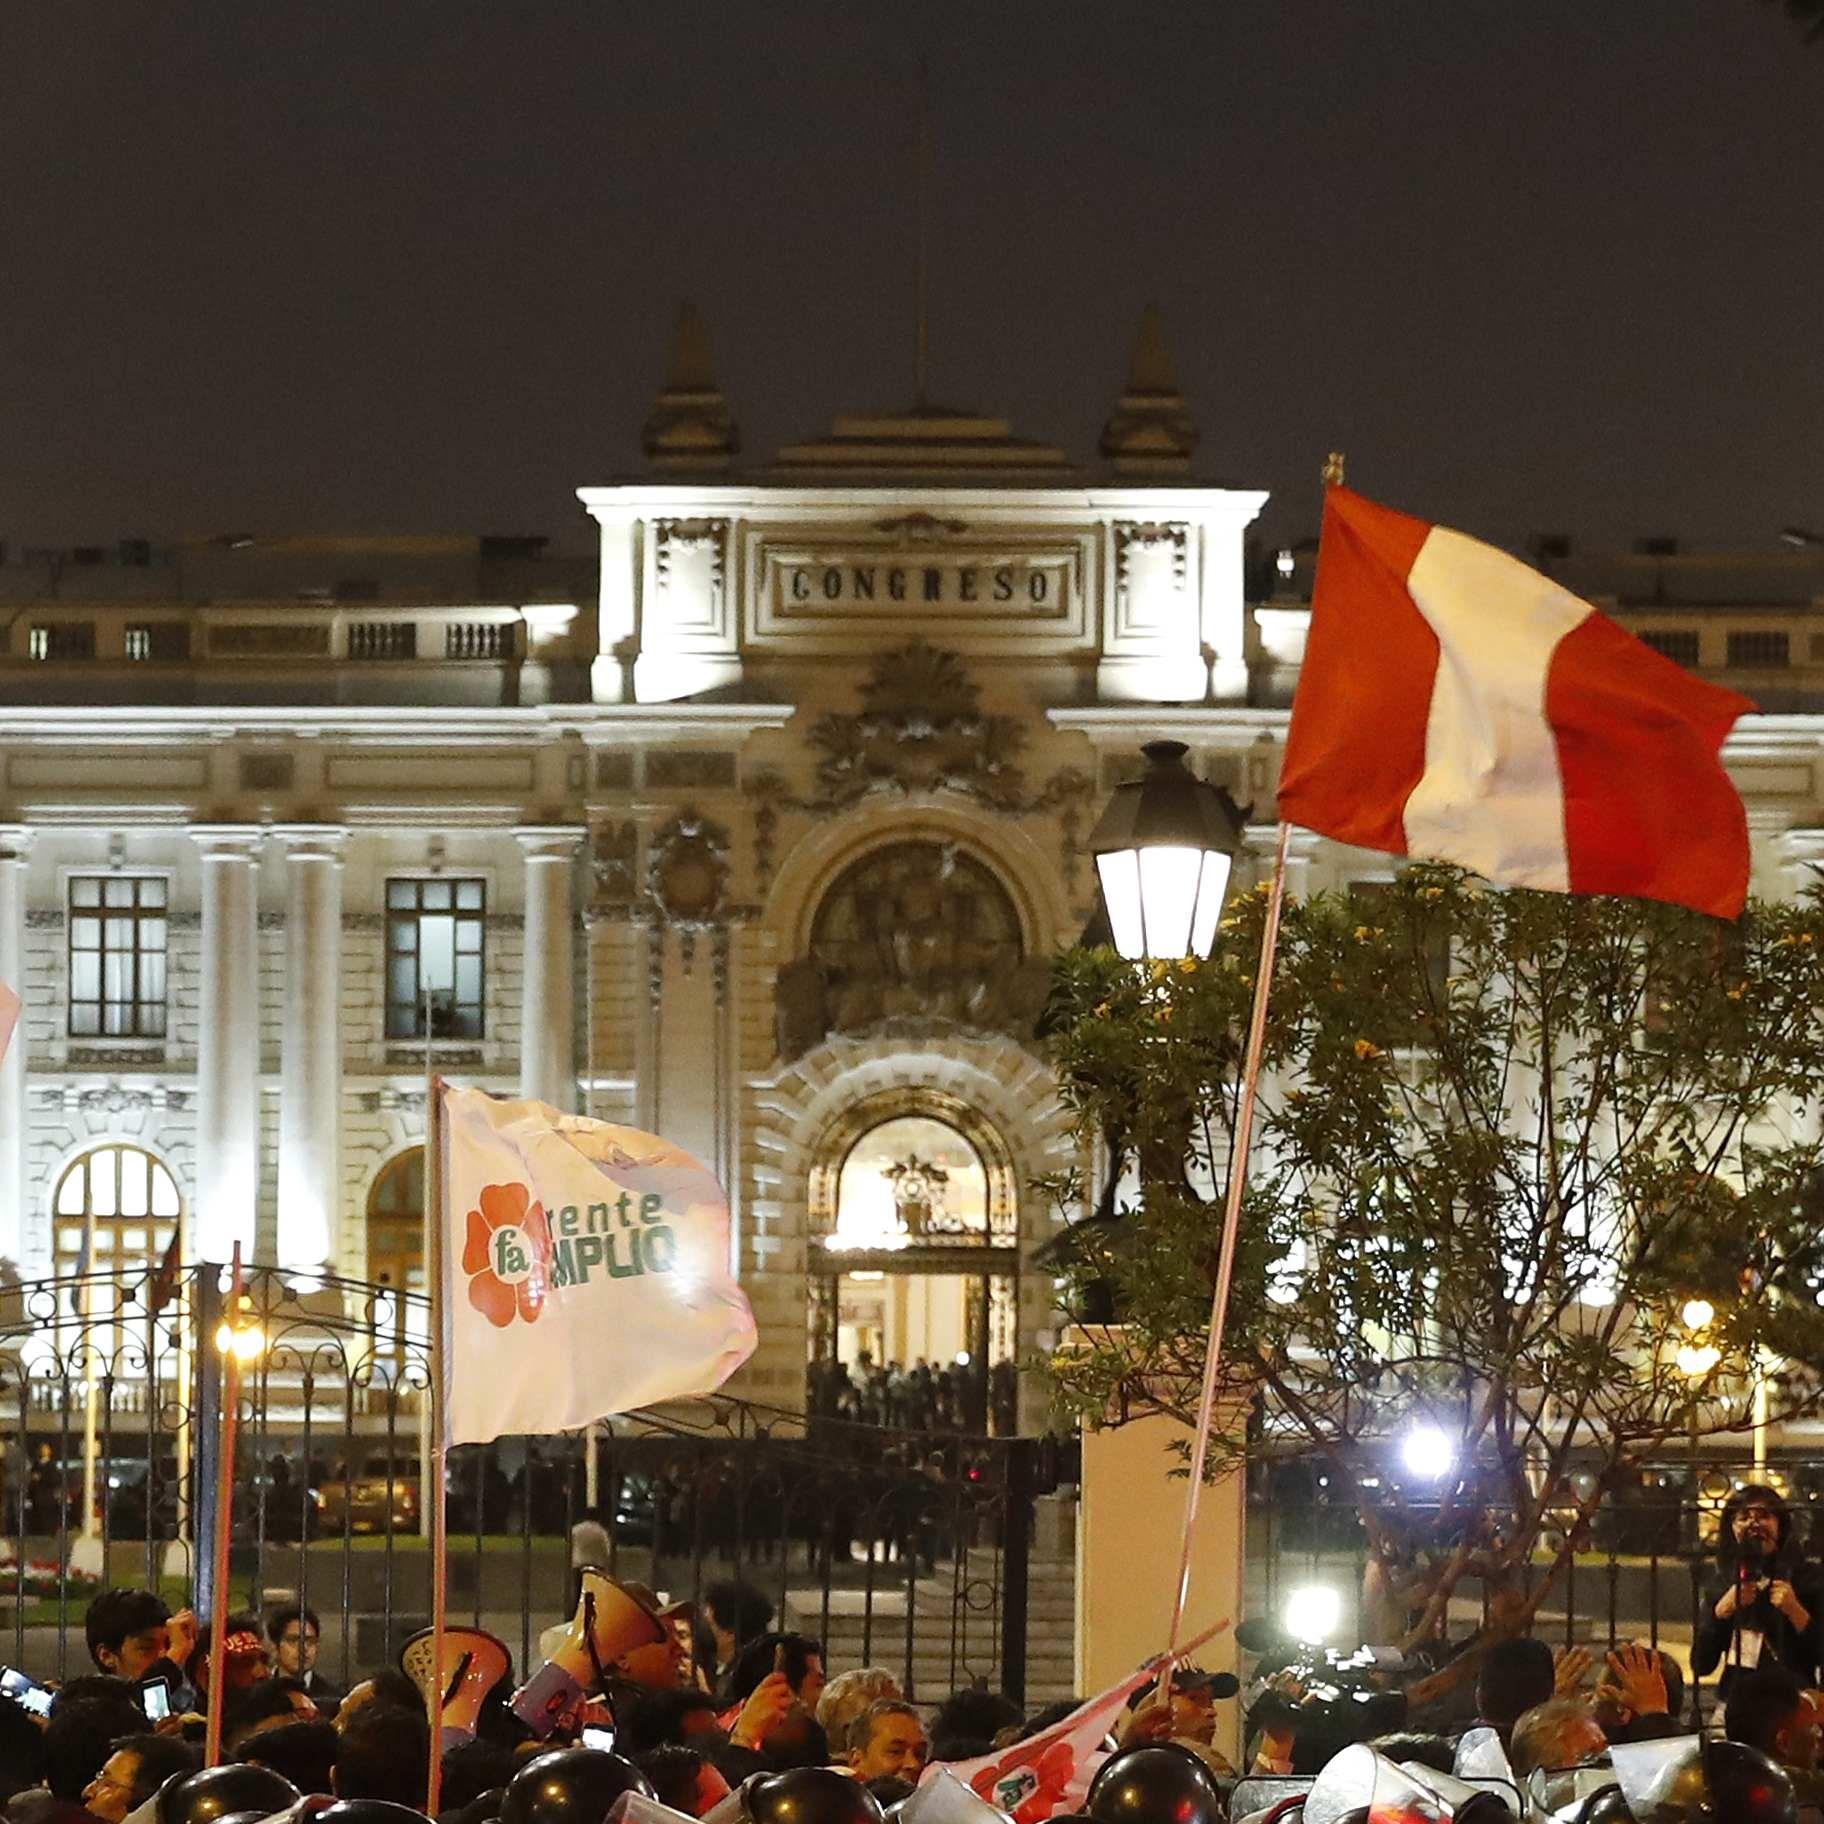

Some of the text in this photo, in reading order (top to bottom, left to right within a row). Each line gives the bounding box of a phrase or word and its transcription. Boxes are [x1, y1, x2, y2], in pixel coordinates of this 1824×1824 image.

[793, 565, 1047, 601] CONGRESO
[546, 1190, 663, 1237] rente
[494, 1230, 529, 1277] fa
[550, 1226, 676, 1289] MPLIO
